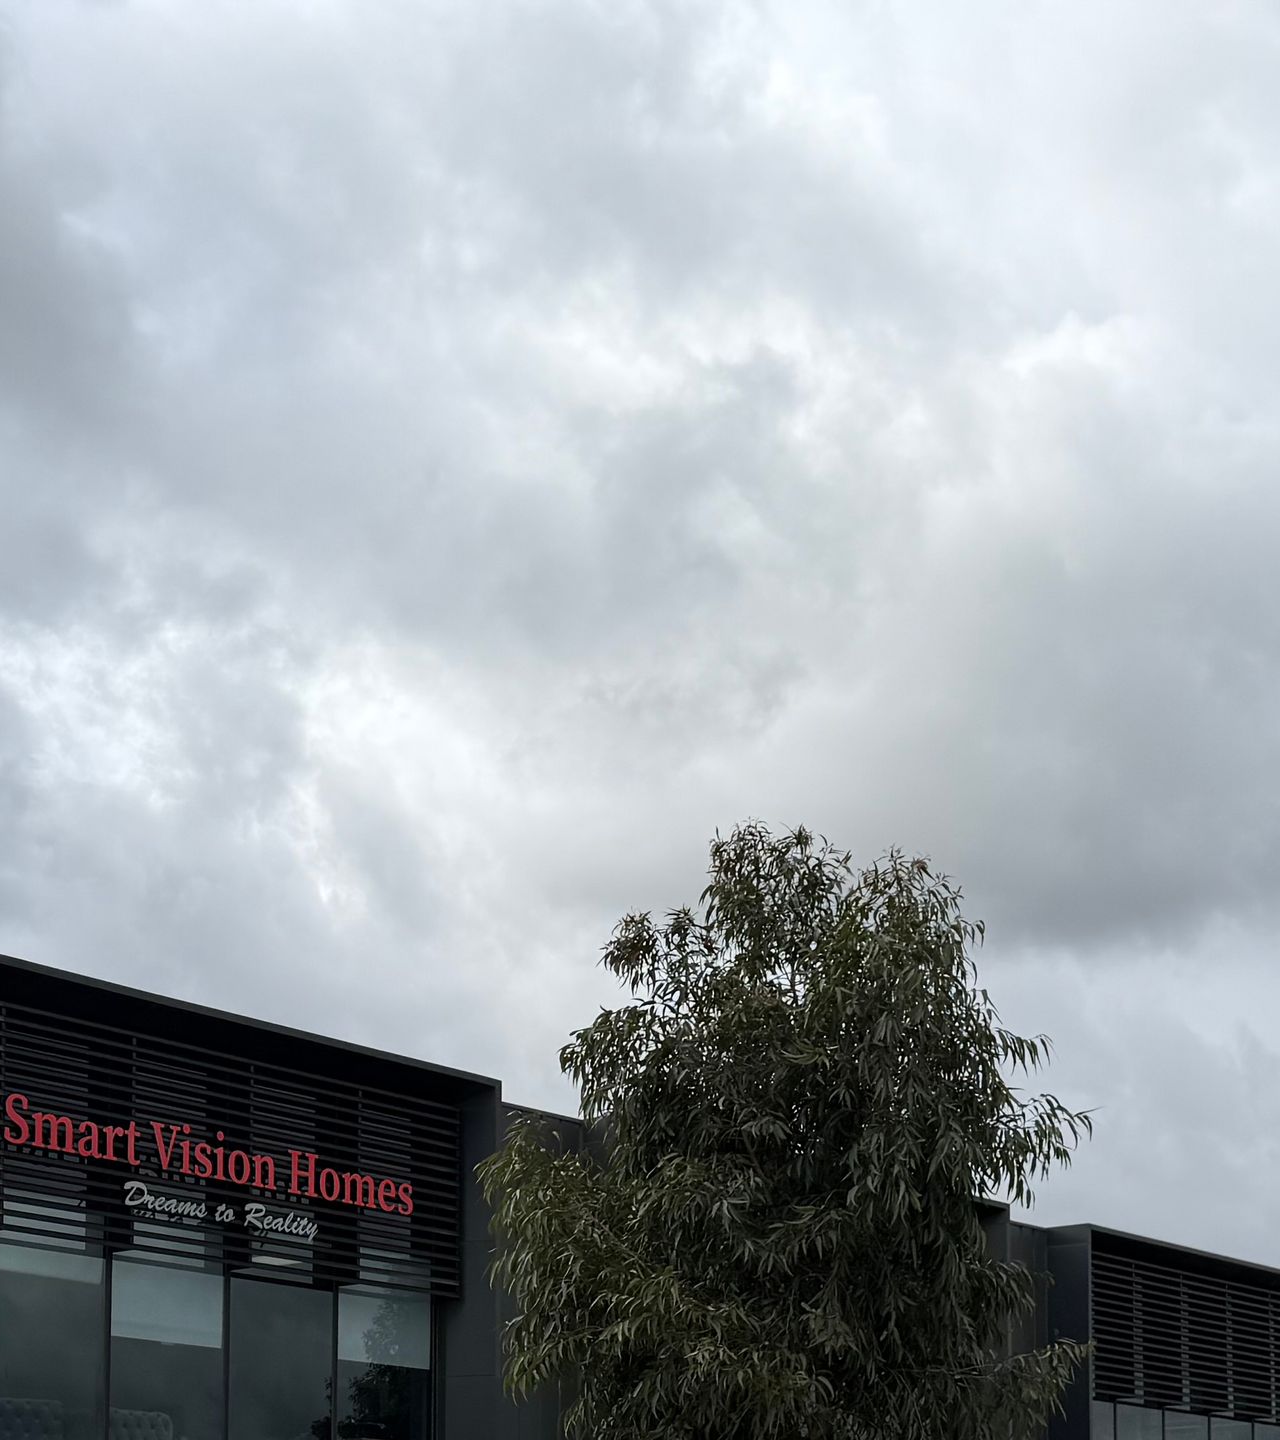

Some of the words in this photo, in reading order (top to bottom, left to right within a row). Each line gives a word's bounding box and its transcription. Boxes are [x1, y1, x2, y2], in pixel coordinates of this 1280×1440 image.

[3, 1093, 141, 1166] Smart
[150, 1121, 276, 1190] Vision
[288, 1149, 414, 1215] Homes
[123, 1180, 208, 1218] Dreams
[214, 1199, 236, 1223] to
[243, 1203, 320, 1240] Reality
